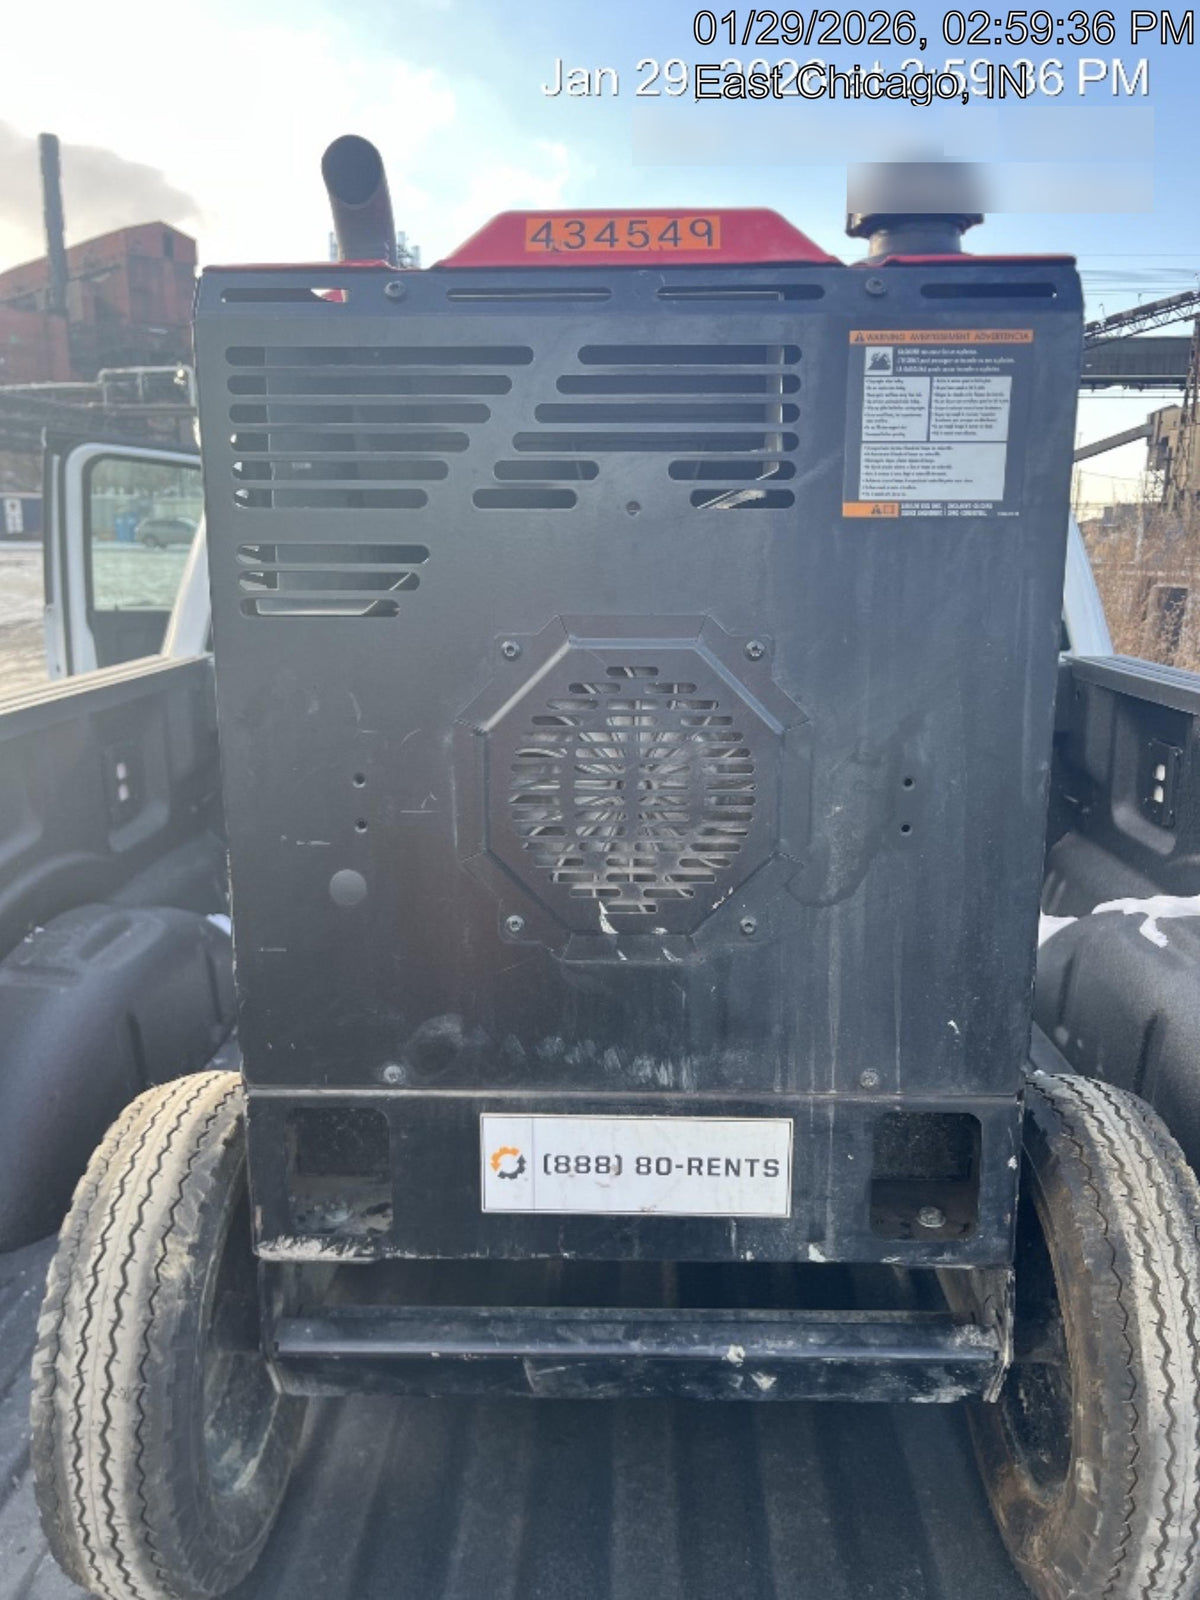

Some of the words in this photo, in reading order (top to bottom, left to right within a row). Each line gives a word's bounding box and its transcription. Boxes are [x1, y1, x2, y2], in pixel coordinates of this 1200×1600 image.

[530, 218, 714, 249] 434549
[543, 1154, 623, 1176] (888)
[635, 1156, 780, 1178] 80-RENTS
